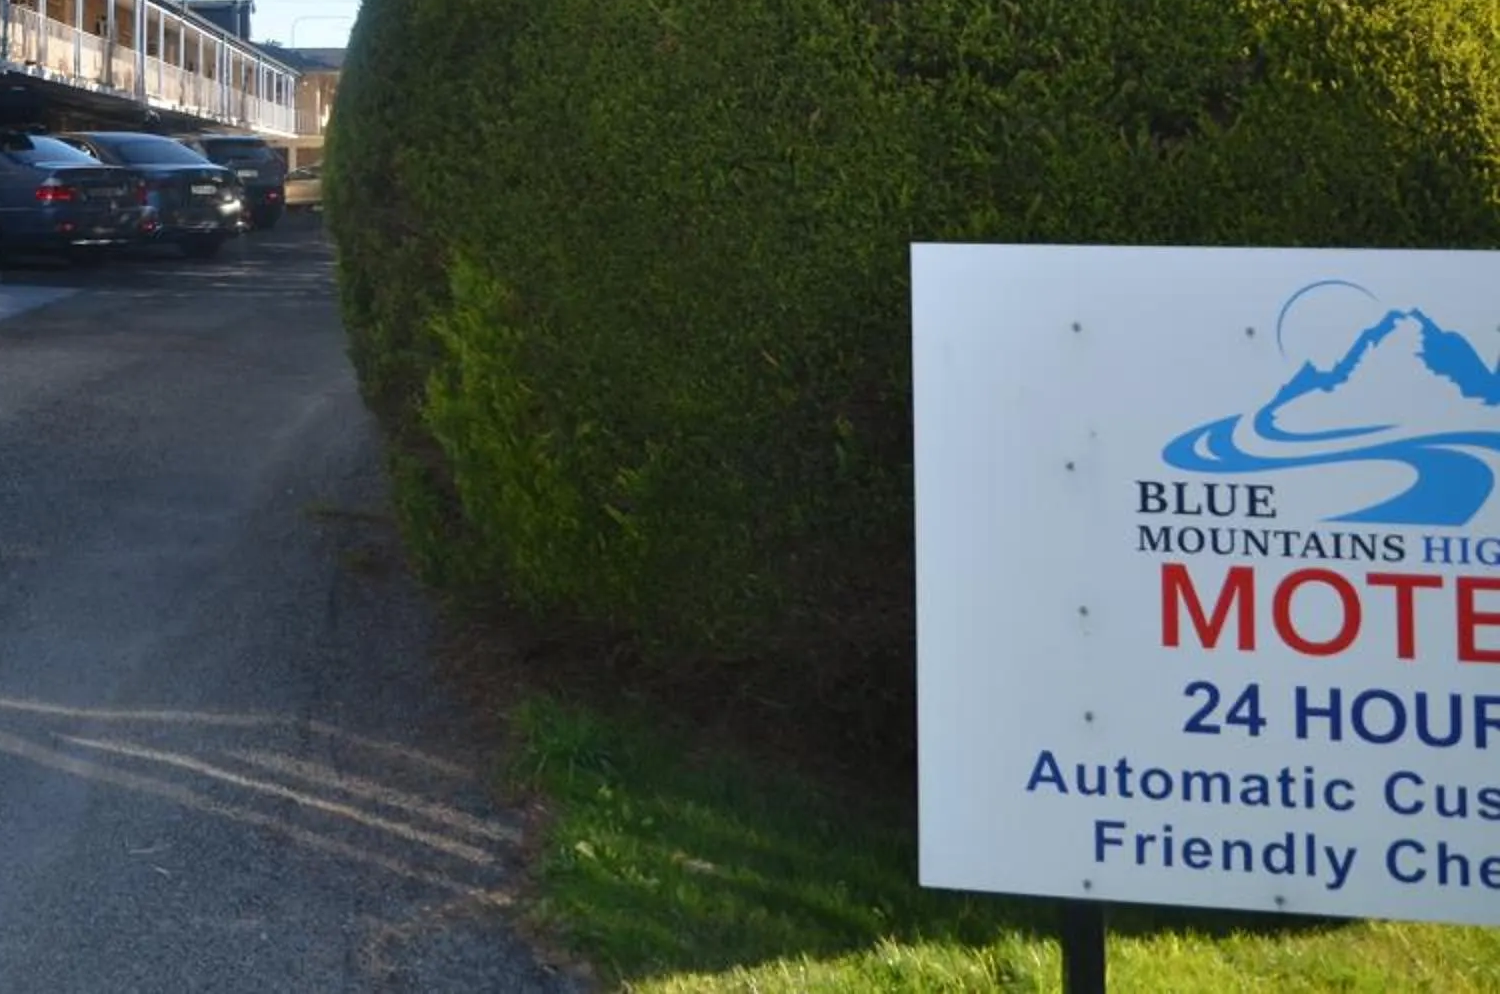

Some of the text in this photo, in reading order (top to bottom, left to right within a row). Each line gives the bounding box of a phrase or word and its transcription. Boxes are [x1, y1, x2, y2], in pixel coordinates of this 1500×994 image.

[1135, 479, 1278, 520] BLUE
[1135, 524, 1500, 566] MOUNTAINS HIG
[1160, 562, 1500, 664] MOTE
[1181, 680, 1268, 739] 24
[1025, 749, 1500, 821] Automatic Cus
[1093, 819, 1500, 891] Friendly Che
